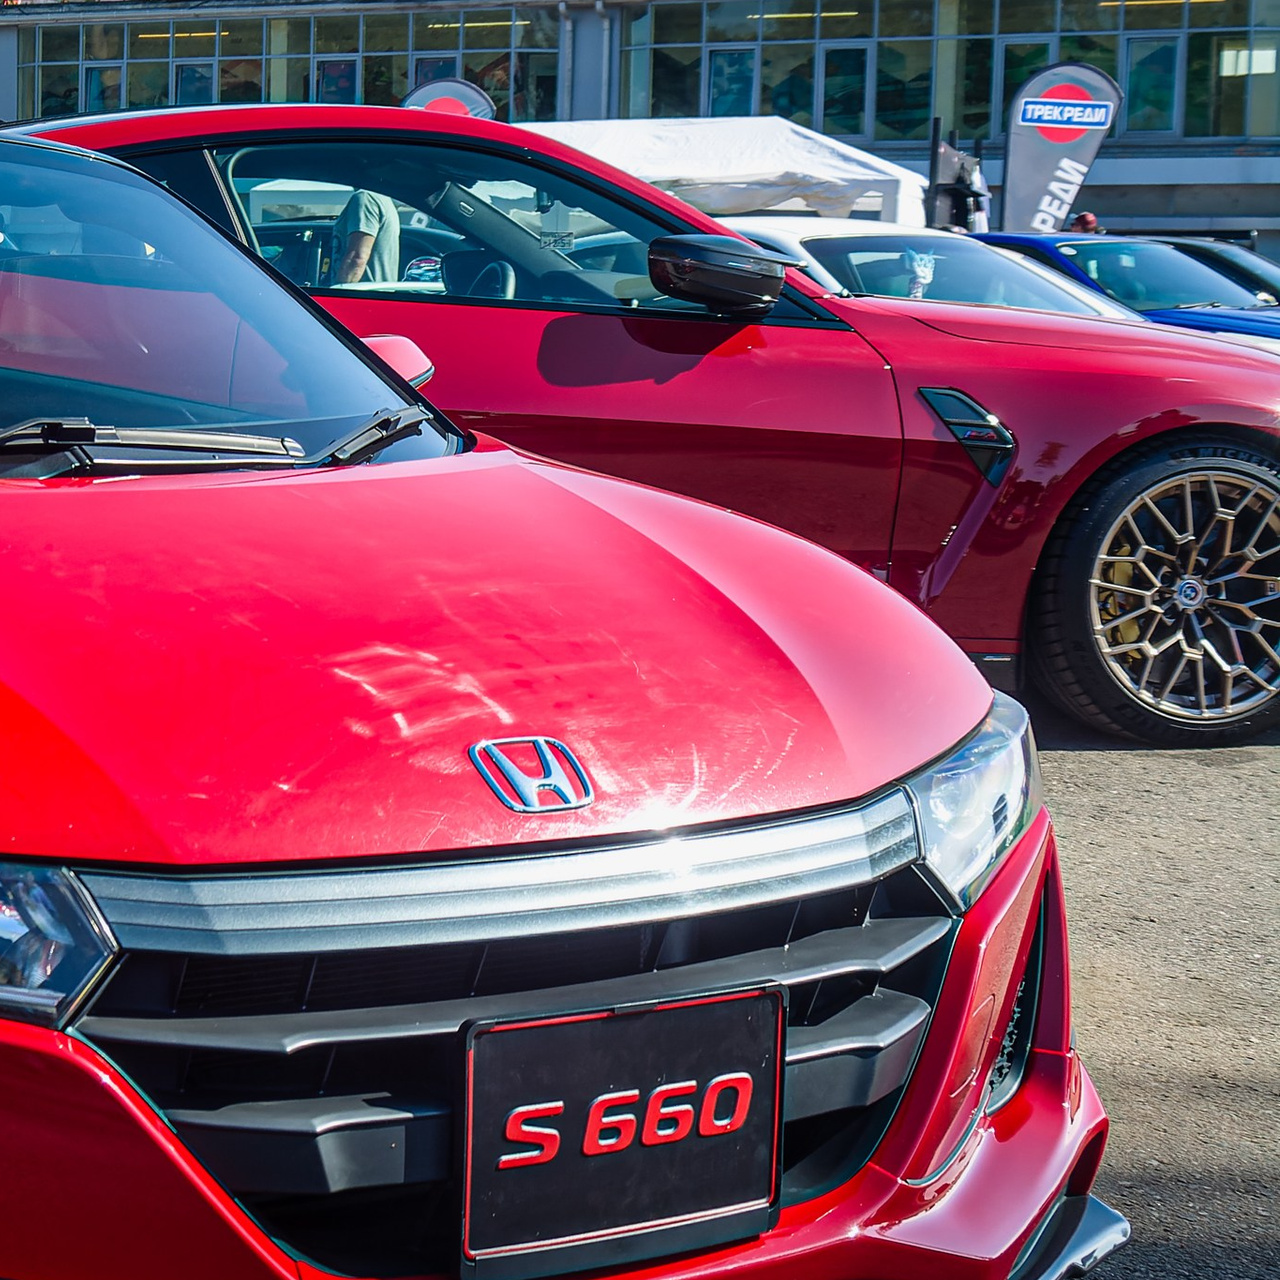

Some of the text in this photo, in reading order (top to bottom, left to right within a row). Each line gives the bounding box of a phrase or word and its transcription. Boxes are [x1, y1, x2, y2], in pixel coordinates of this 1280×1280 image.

[1024, 103, 1107, 123] ТРЕКРЕДИ
[498, 1071, 754, 1170] S 660
